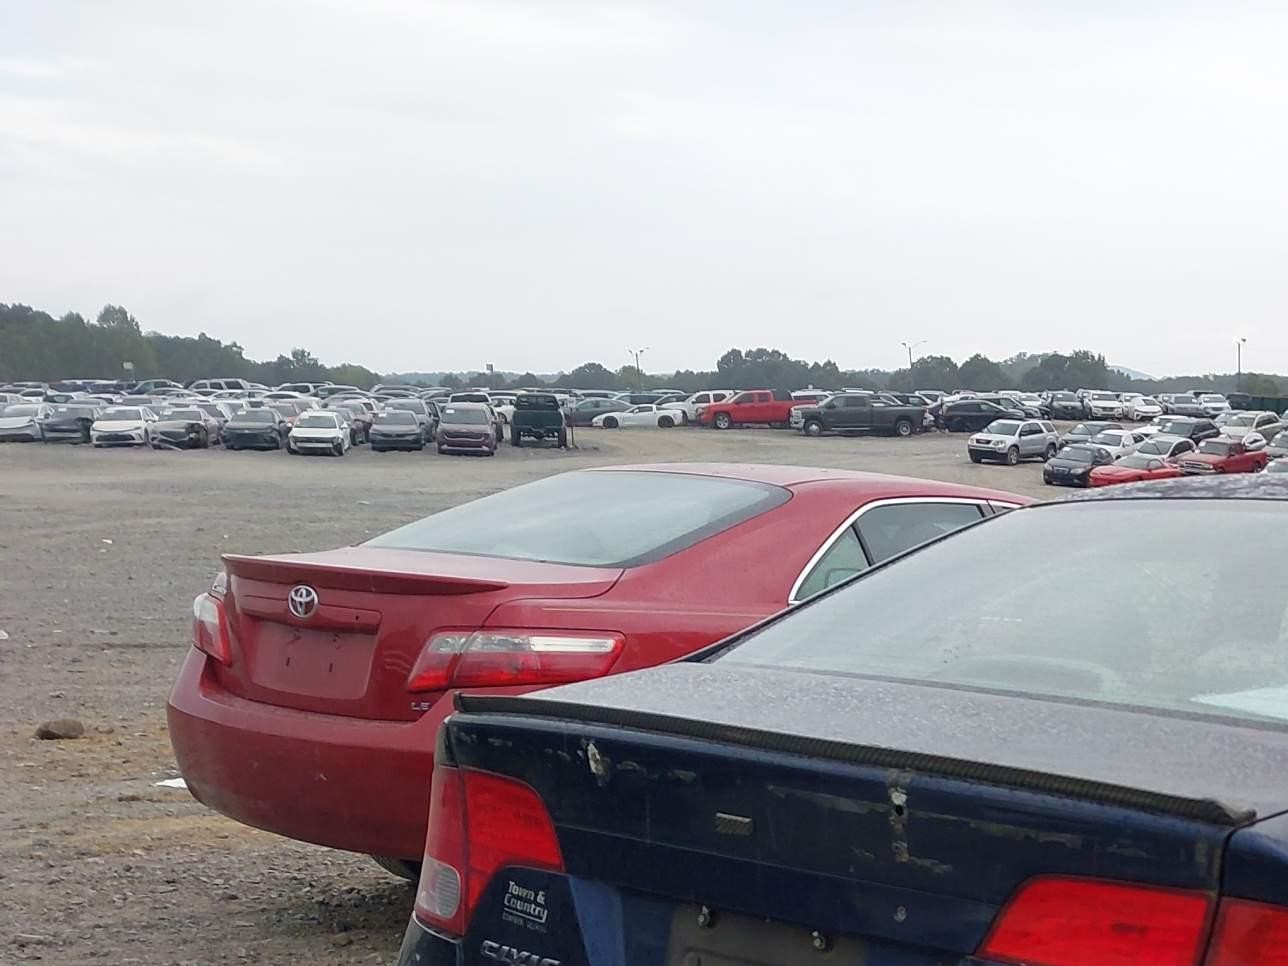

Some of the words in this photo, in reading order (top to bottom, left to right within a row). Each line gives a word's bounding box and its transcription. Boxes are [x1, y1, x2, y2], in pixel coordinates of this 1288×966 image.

[410, 702, 431, 711] LE
[507, 880, 534, 901] Town
[536, 891, 546, 905] &
[503, 893, 548, 920] Country
